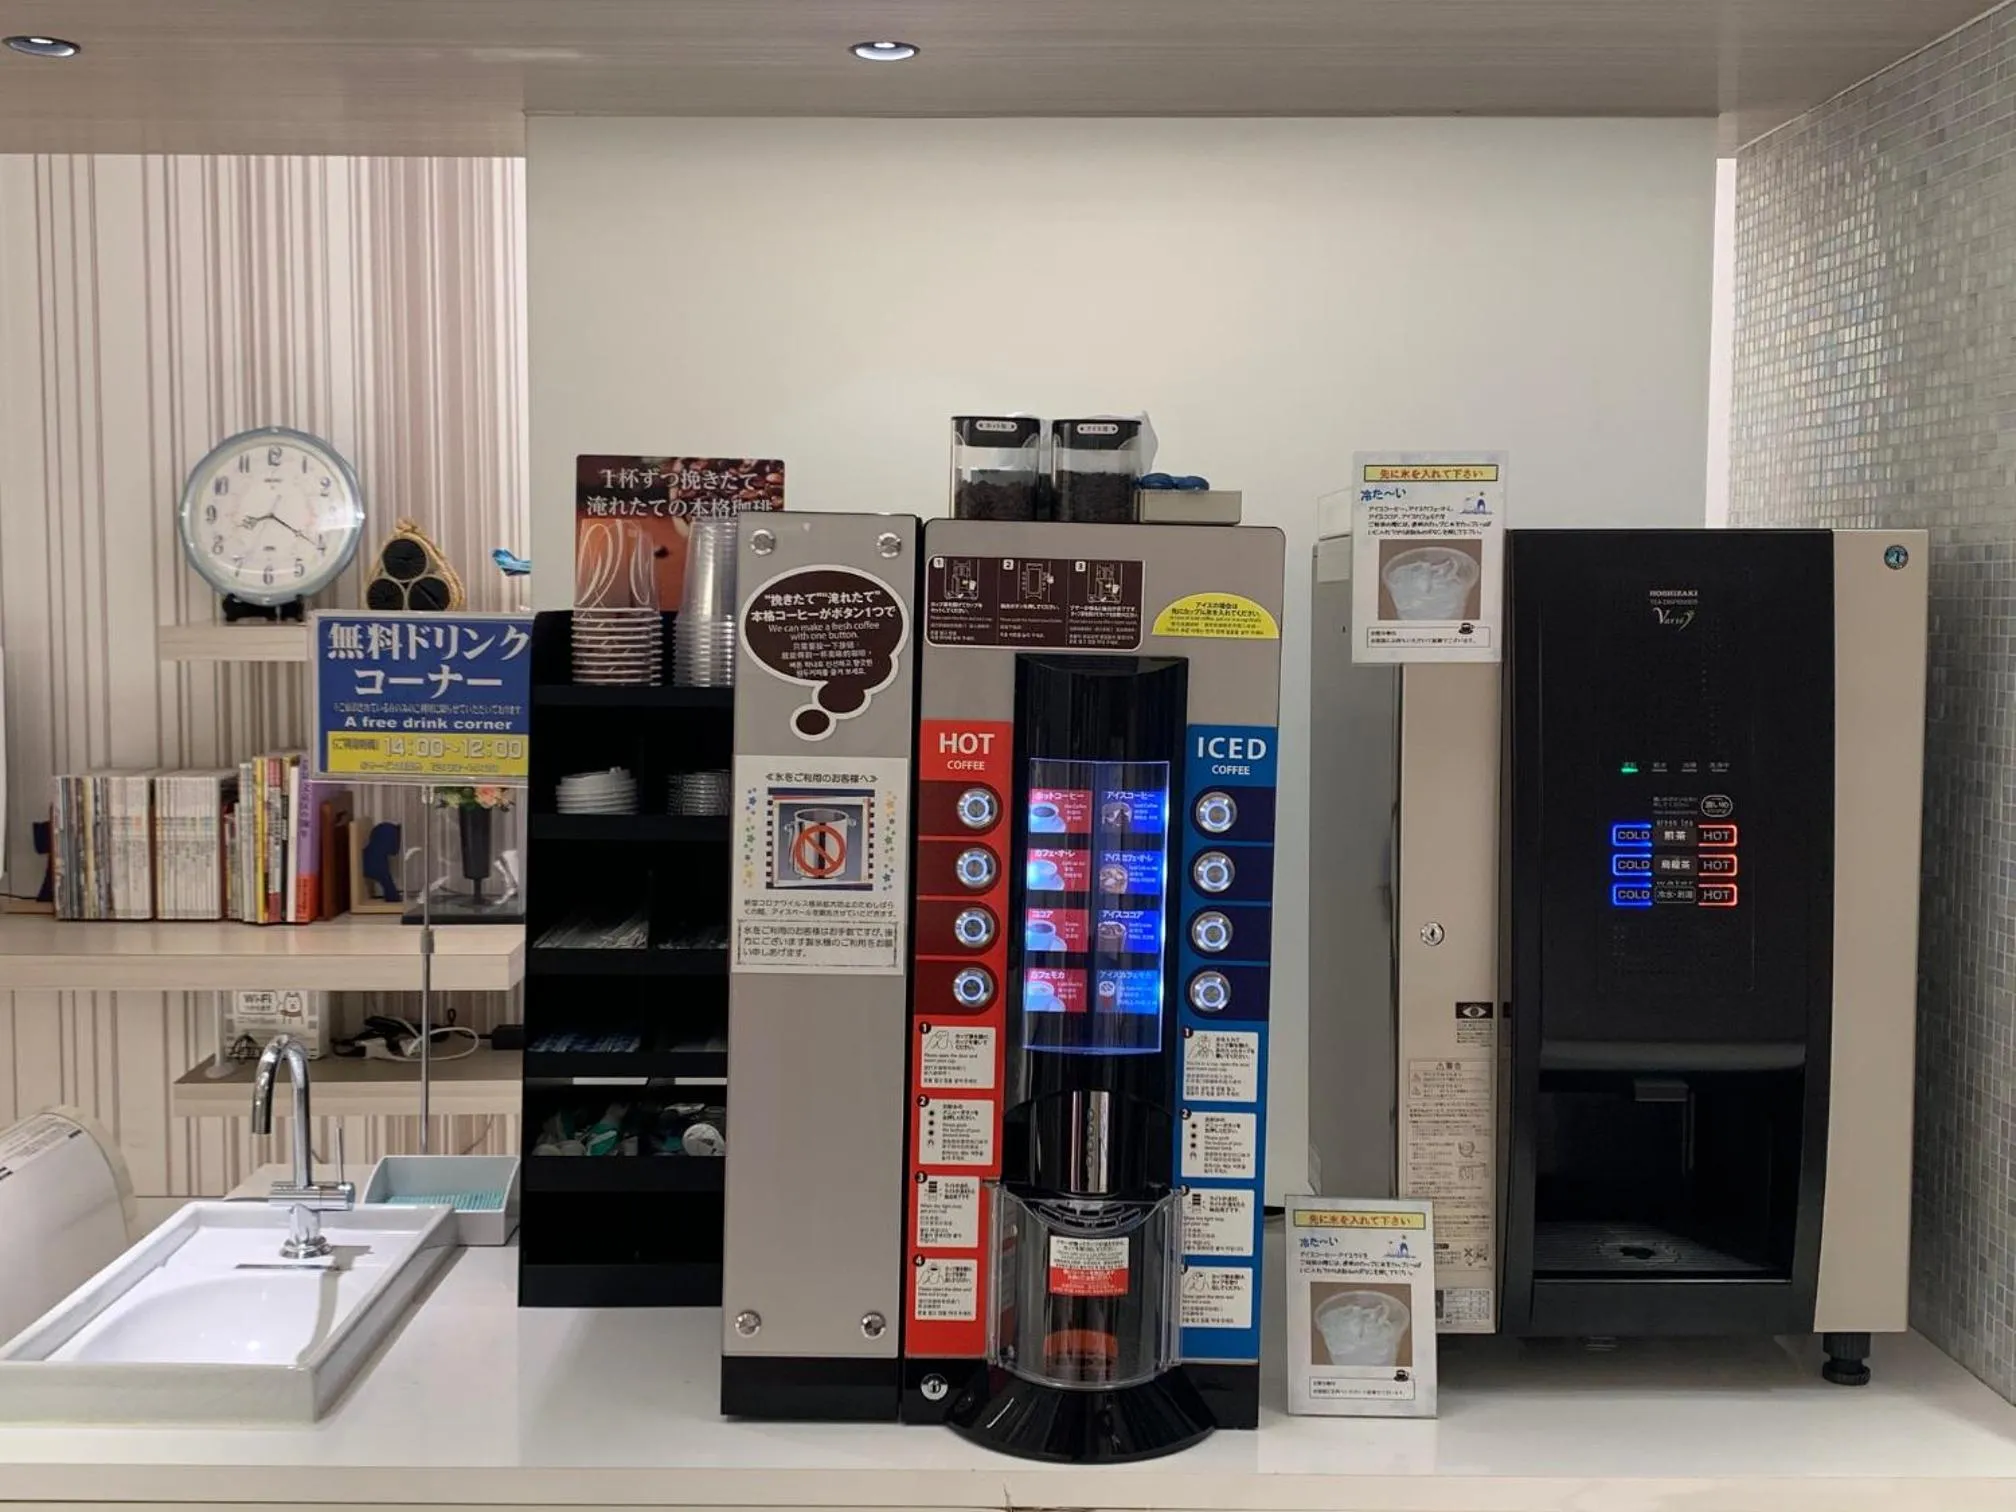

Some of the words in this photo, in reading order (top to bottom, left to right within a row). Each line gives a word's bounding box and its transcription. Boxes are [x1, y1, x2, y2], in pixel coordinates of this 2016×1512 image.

[238, 455, 250, 474] 11
[302, 455, 308, 474] 1
[205, 504, 218, 525] 9
[934, 558, 943, 569] 1
[1004, 560, 1012, 570] 2
[262, 565, 274, 586] 6
[768, 625, 782, 633] We
[800, 624, 824, 632] make
[854, 621, 880, 630] coffee
[327, 622, 530, 661] 無料ドリンク
[791, 633, 810, 641] with
[353, 663, 503, 699] コーナー
[344, 716, 357, 728] A
[362, 716, 397, 729] free
[403, 716, 448, 730] drink
[454, 719, 512, 730] corner
[939, 732, 996, 755] HOT
[1197, 736, 1267, 760] ICED
[946, 760, 986, 771] COFFEE
[1211, 764, 1251, 776] COFFEE
[1106, 791, 1156, 800] アイスコーヒー
[1617, 831, 1650, 840] COLD
[1703, 831, 1731, 840] HOT
[1617, 860, 1650, 869] COLD
[1703, 860, 1731, 869] HOT
[1617, 890, 1650, 899] COLD
[1703, 890, 1731, 899] HOT
